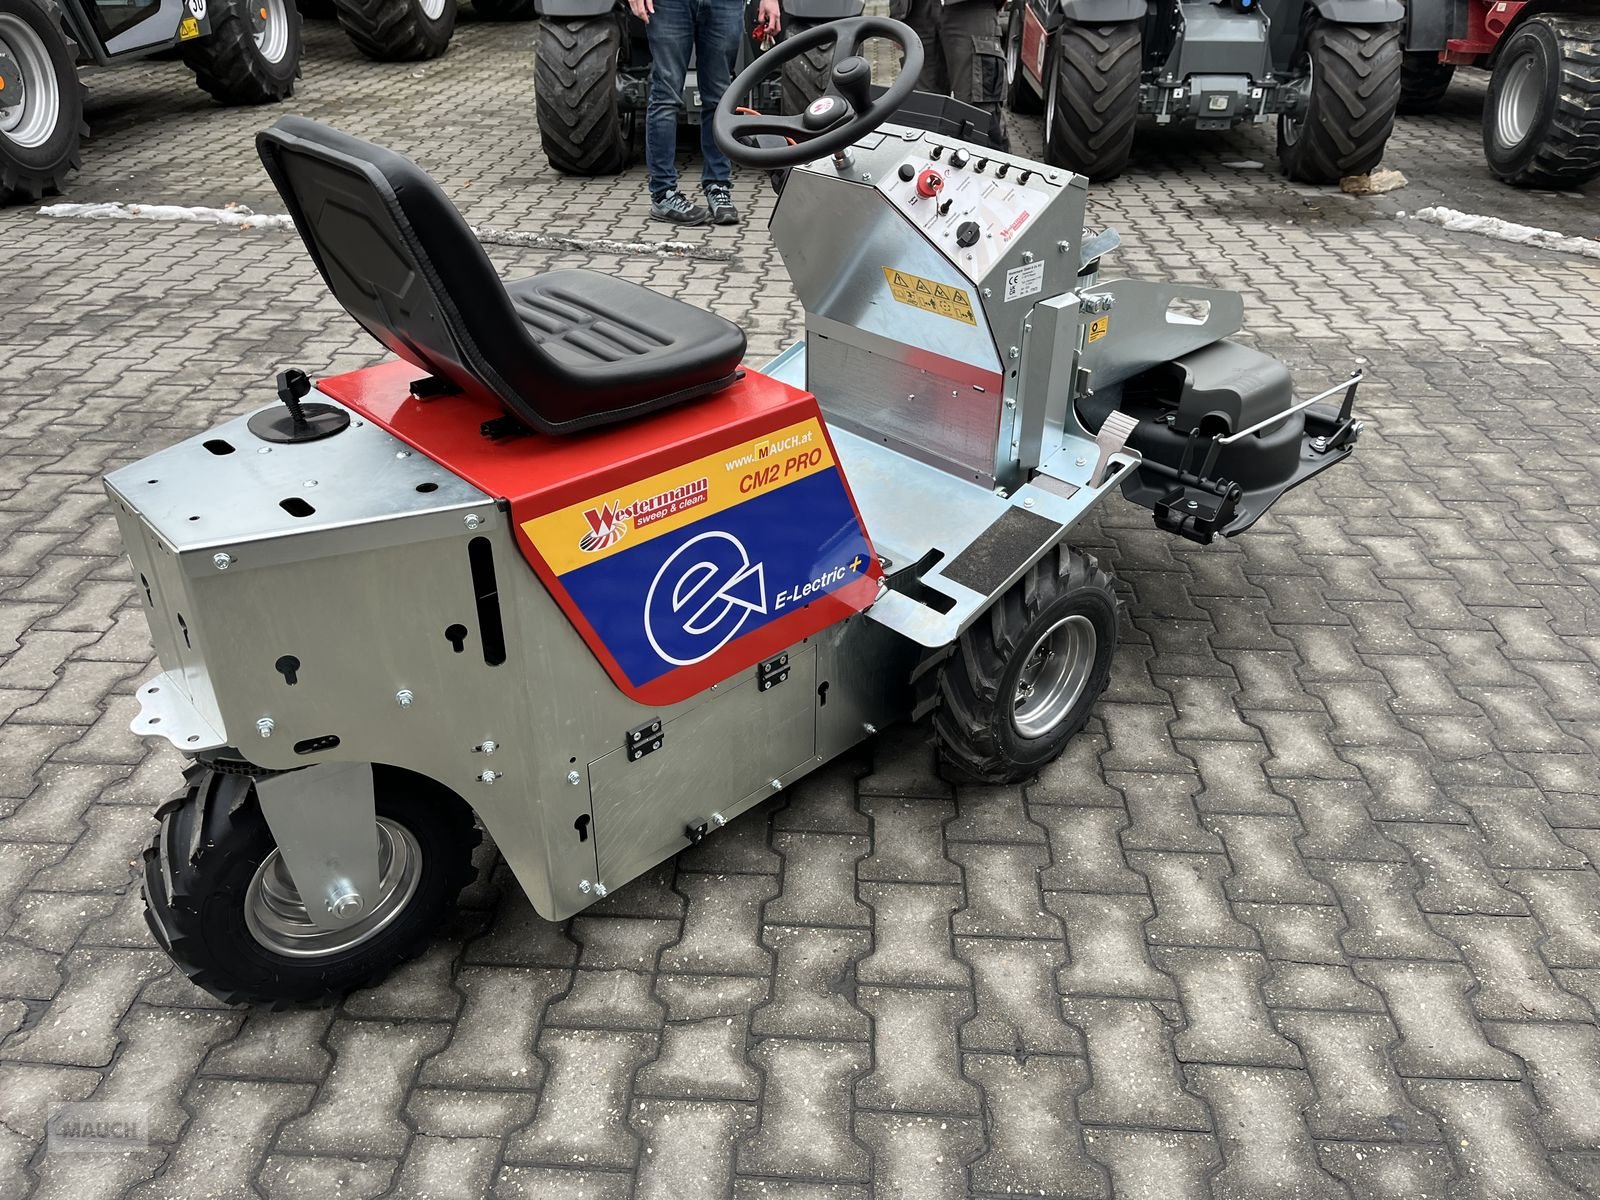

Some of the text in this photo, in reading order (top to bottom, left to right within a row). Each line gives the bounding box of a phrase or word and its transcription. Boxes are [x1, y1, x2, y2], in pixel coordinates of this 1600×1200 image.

[725, 431, 812, 471] www.MAUCH.at
[739, 447, 821, 493] CM2 PRO
[583, 478, 708, 537] Westermann
[637, 494, 706, 526] sweep & clean.
[775, 566, 846, 610] E-Lectric
